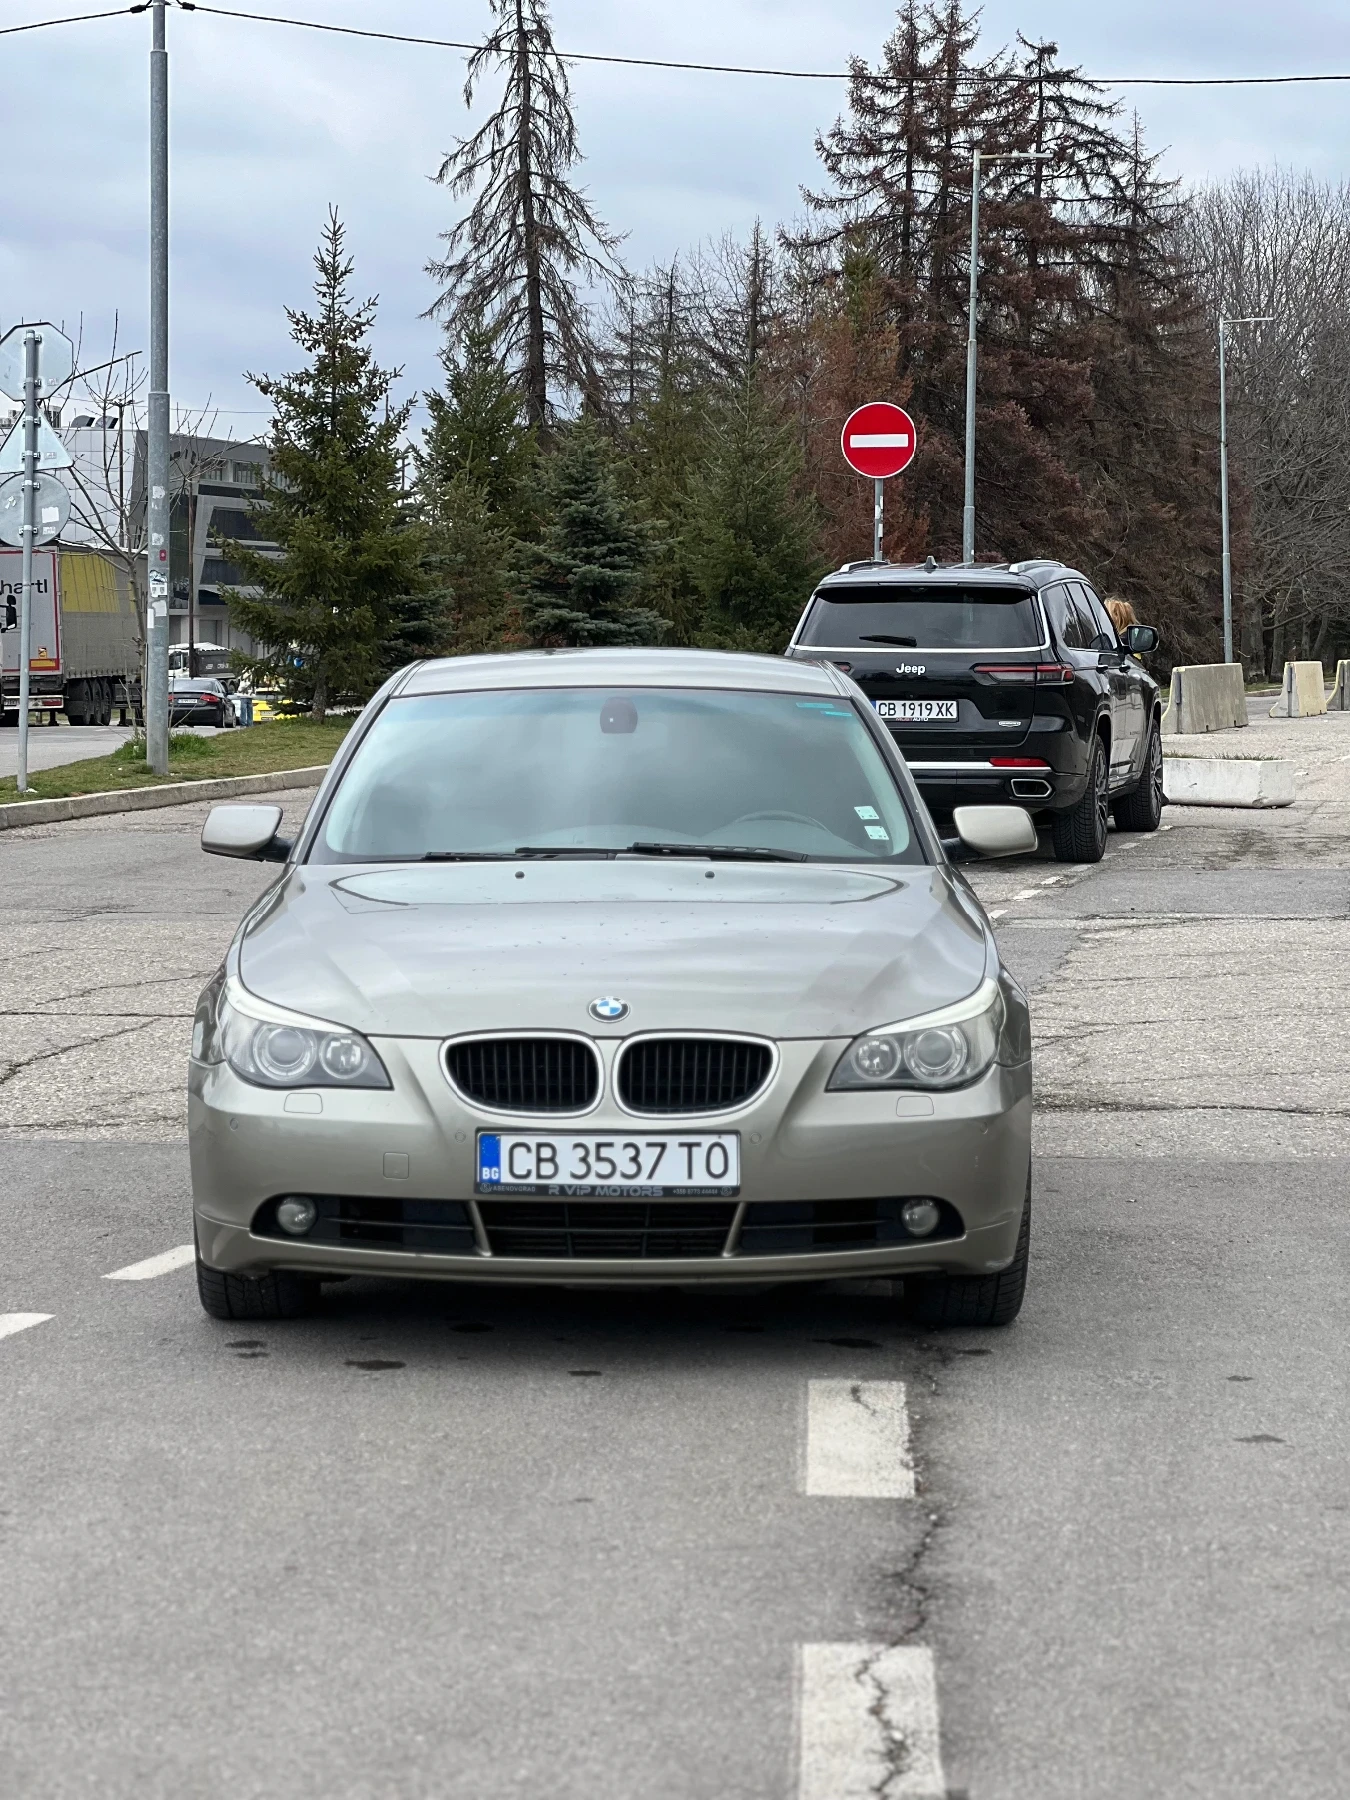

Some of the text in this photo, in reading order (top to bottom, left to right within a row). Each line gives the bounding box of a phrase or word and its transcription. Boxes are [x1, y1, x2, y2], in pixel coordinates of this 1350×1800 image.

[1, 579, 48, 595] hatl
[896, 663, 926, 676] Jeep
[878, 702, 954, 717] CB 1919 XK
[508, 1142, 729, 1180] CB 3537 TO
[482, 1167, 499, 1180] BG
[548, 1186, 560, 1195] R
[595, 1186, 664, 1197] MOTORS
